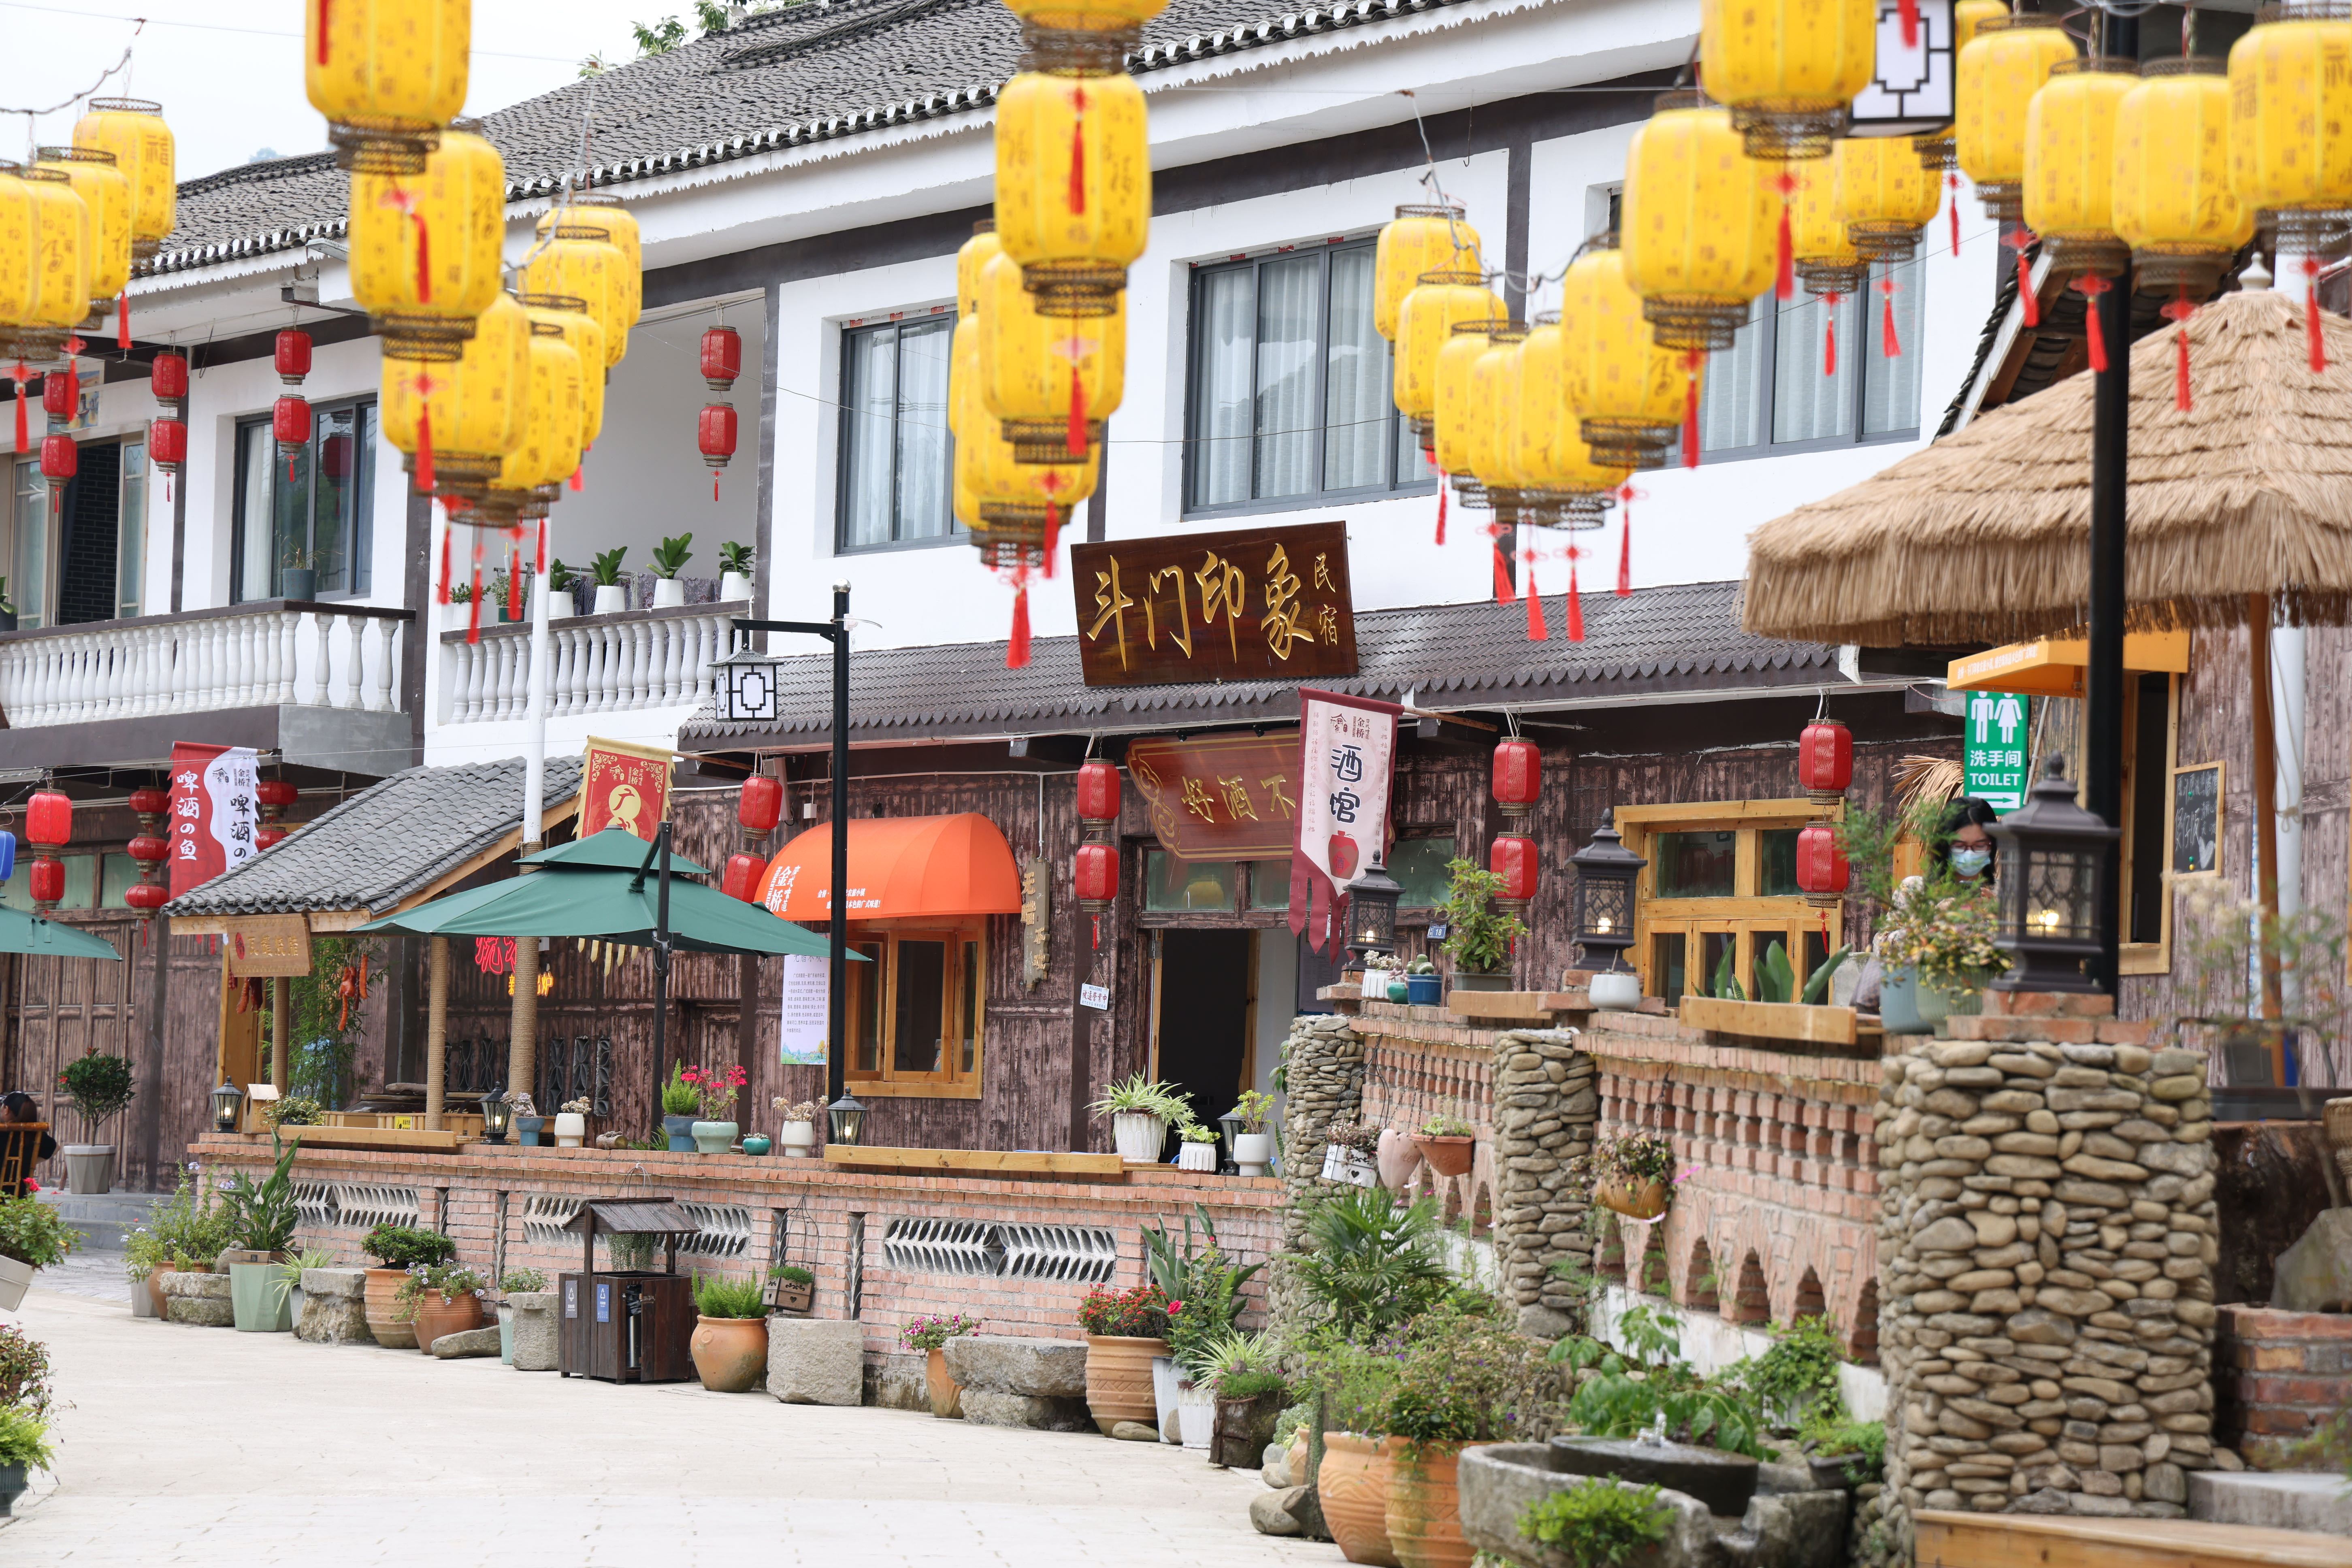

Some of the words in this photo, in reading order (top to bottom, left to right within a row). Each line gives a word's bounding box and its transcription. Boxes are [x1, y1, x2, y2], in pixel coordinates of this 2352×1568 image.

[1086, 543, 1314, 672] 斗门印象
[1314, 552, 1338, 646] 民宿
[1356, 717, 1365, 739] 金桥
[237, 769, 245, 786] 金桥
[631, 767, 639, 785] 金桥
[1970, 750, 2021, 767] 洗手间
[1970, 773, 2021, 786] TOILET
[1181, 774, 1296, 823] 好酒不
[1329, 744, 1363, 824] 酒馆
[176, 770, 200, 861] 啤酒の鱼
[230, 793, 251, 859] 啤酒の
[770, 866, 792, 912] 金桥
